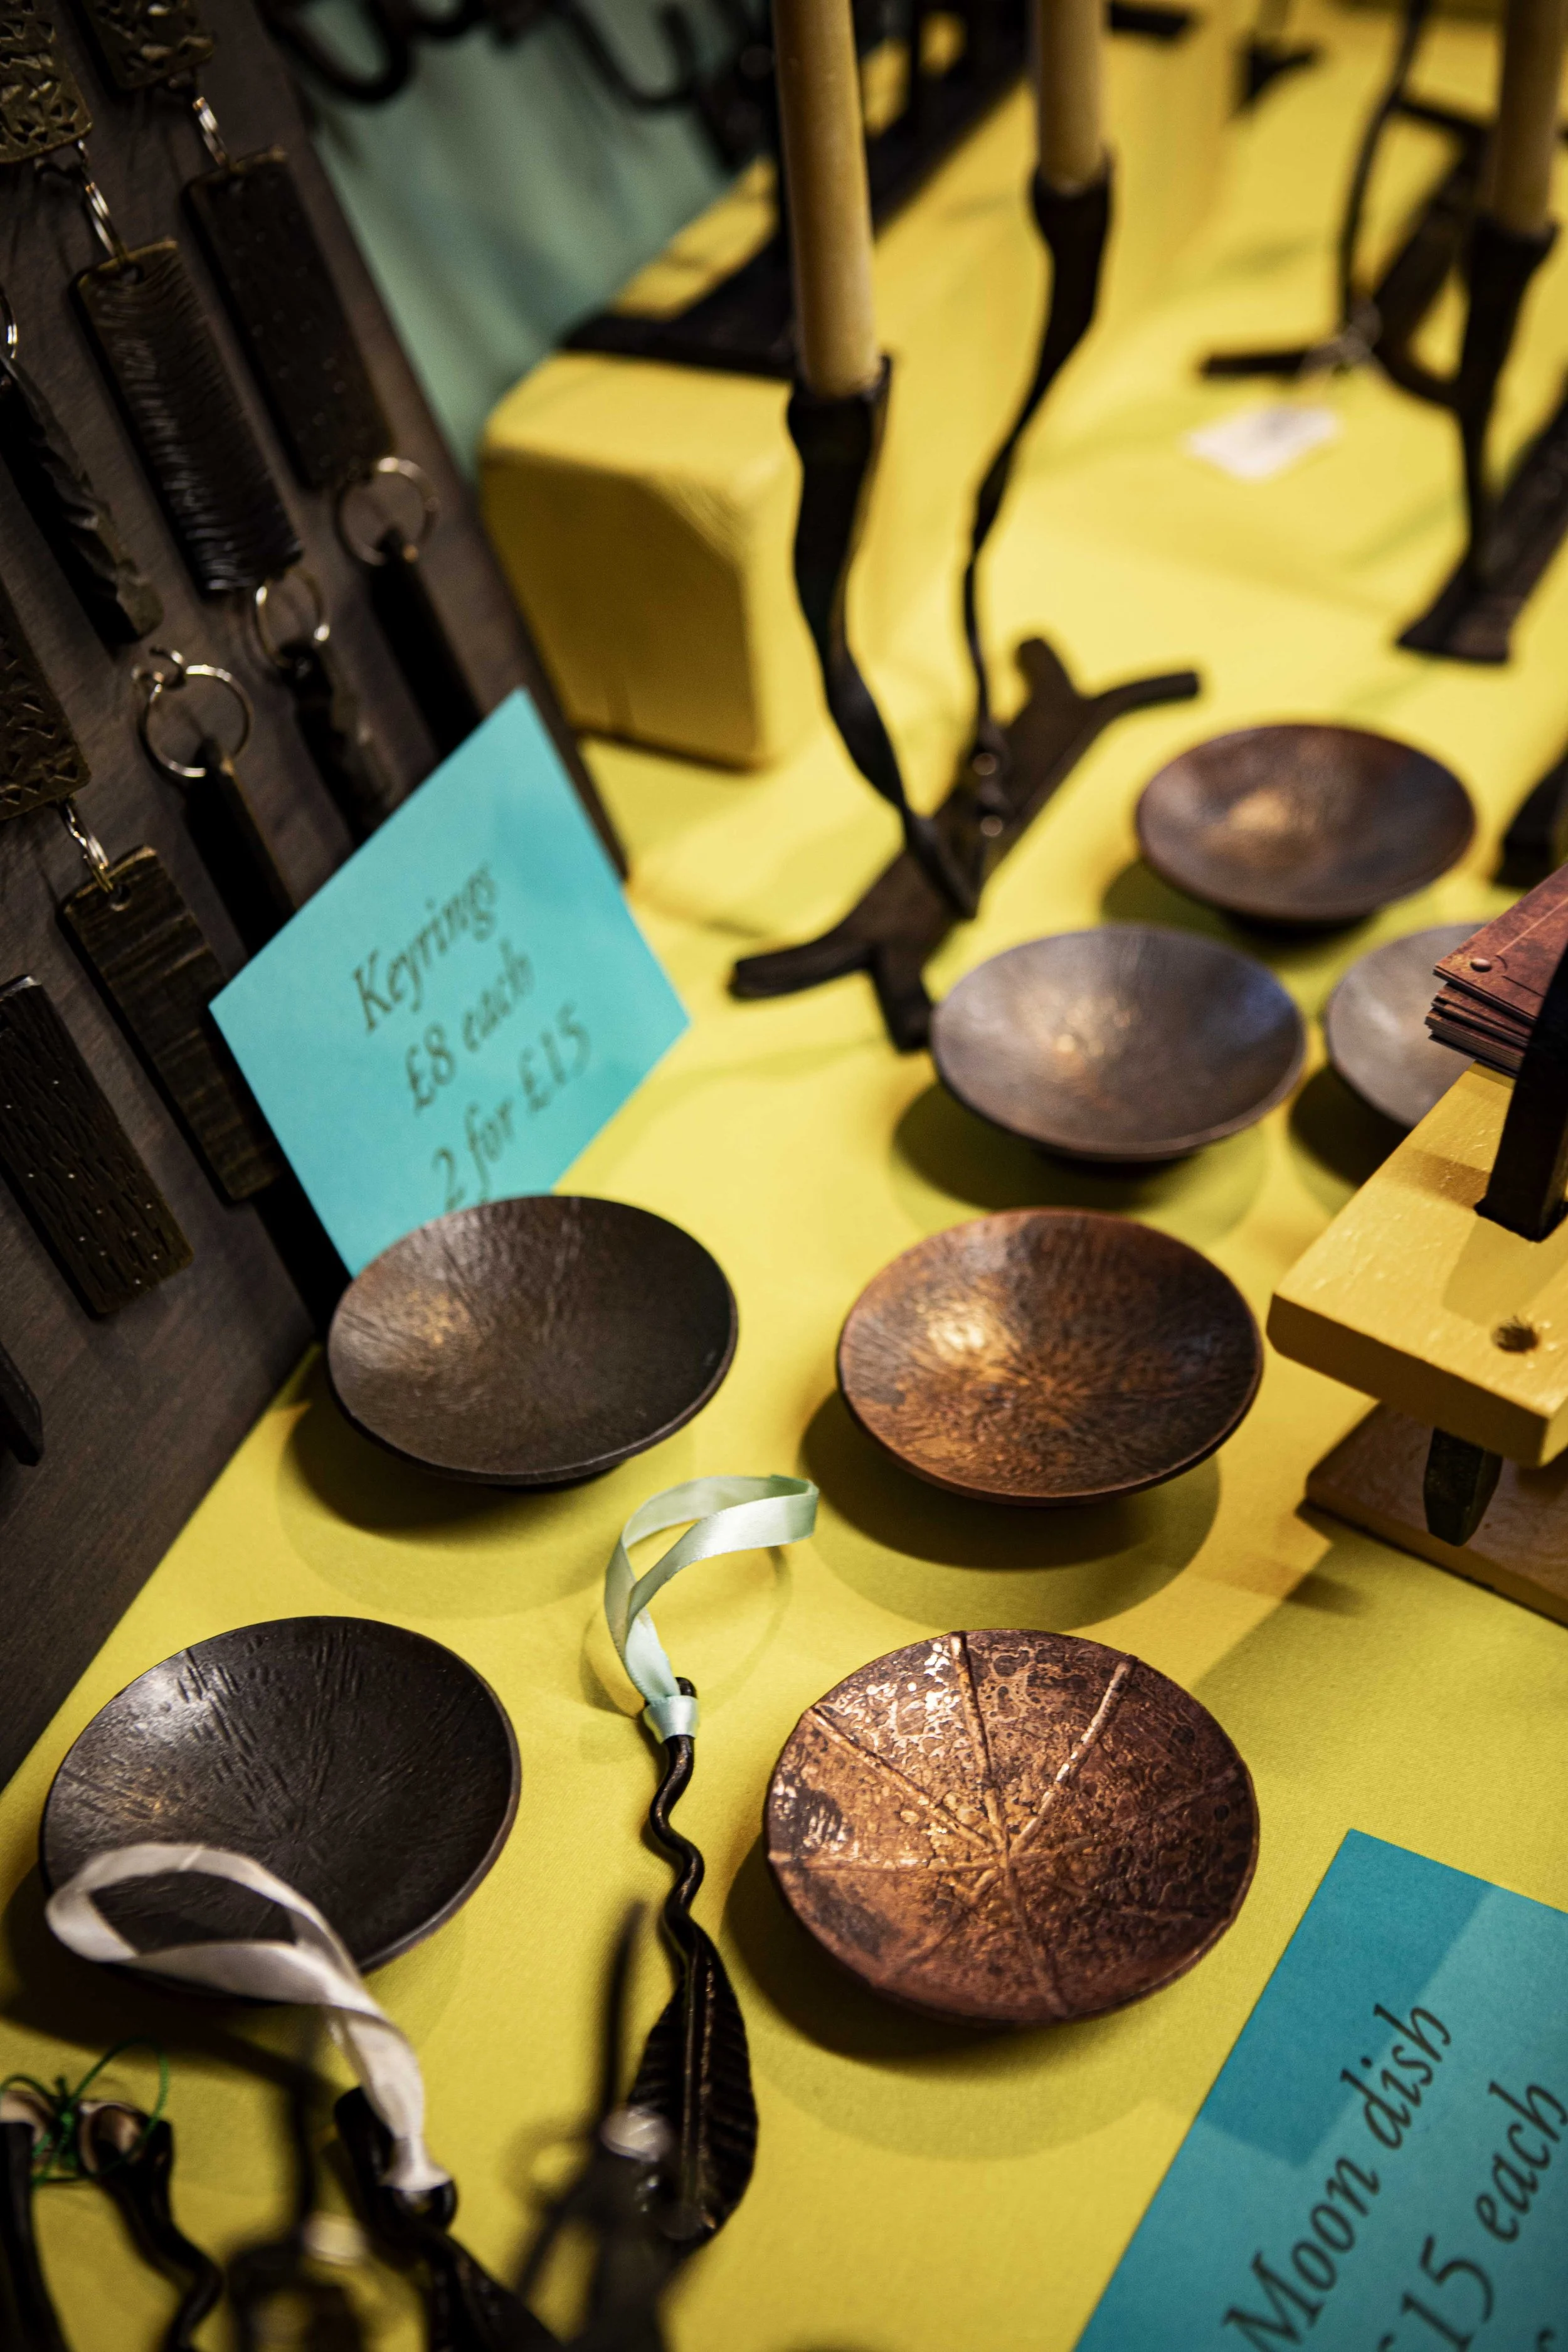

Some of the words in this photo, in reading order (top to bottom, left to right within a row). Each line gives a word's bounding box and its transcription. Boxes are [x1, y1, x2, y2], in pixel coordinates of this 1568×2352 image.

[352, 862, 496, 1035] Keyrings
[405, 1021, 455, 1115] £8
[462, 937, 536, 1054] each
[432, 1145, 467, 1216] 2
[463, 1098, 514, 1204] for
[517, 1002, 592, 1116] £15
[1222, 2156, 1380, 2352] Moon
[1338, 2003, 1451, 2151] dish
[1378, 2233, 1495, 2352] 15
[1475, 2080, 1568, 2244] each
